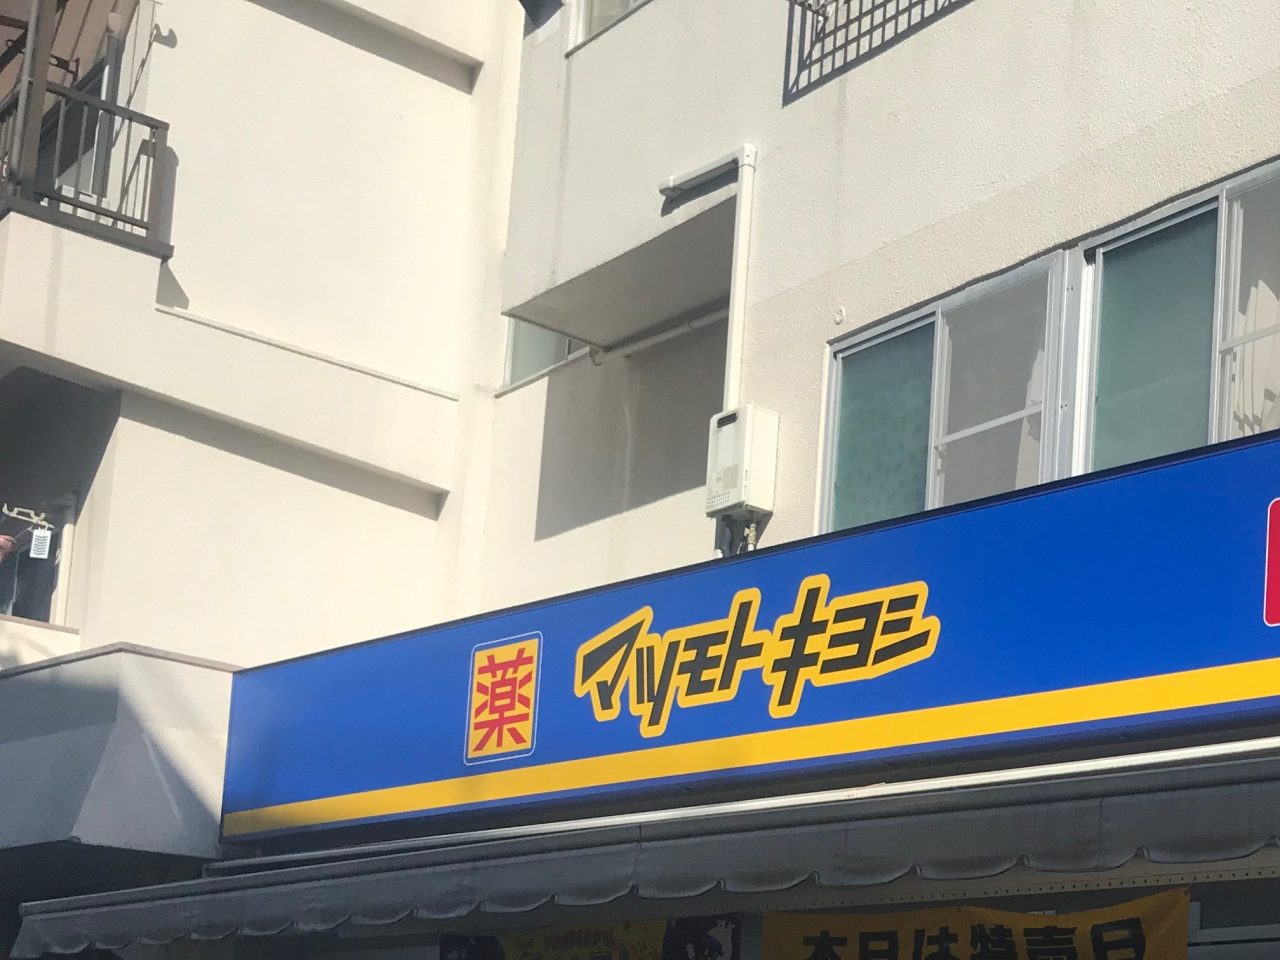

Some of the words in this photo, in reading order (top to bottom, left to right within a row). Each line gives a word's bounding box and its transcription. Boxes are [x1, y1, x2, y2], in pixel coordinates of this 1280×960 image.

[472, 646, 535, 754] 薬
[578, 577, 938, 734] マツモトキヨシ
